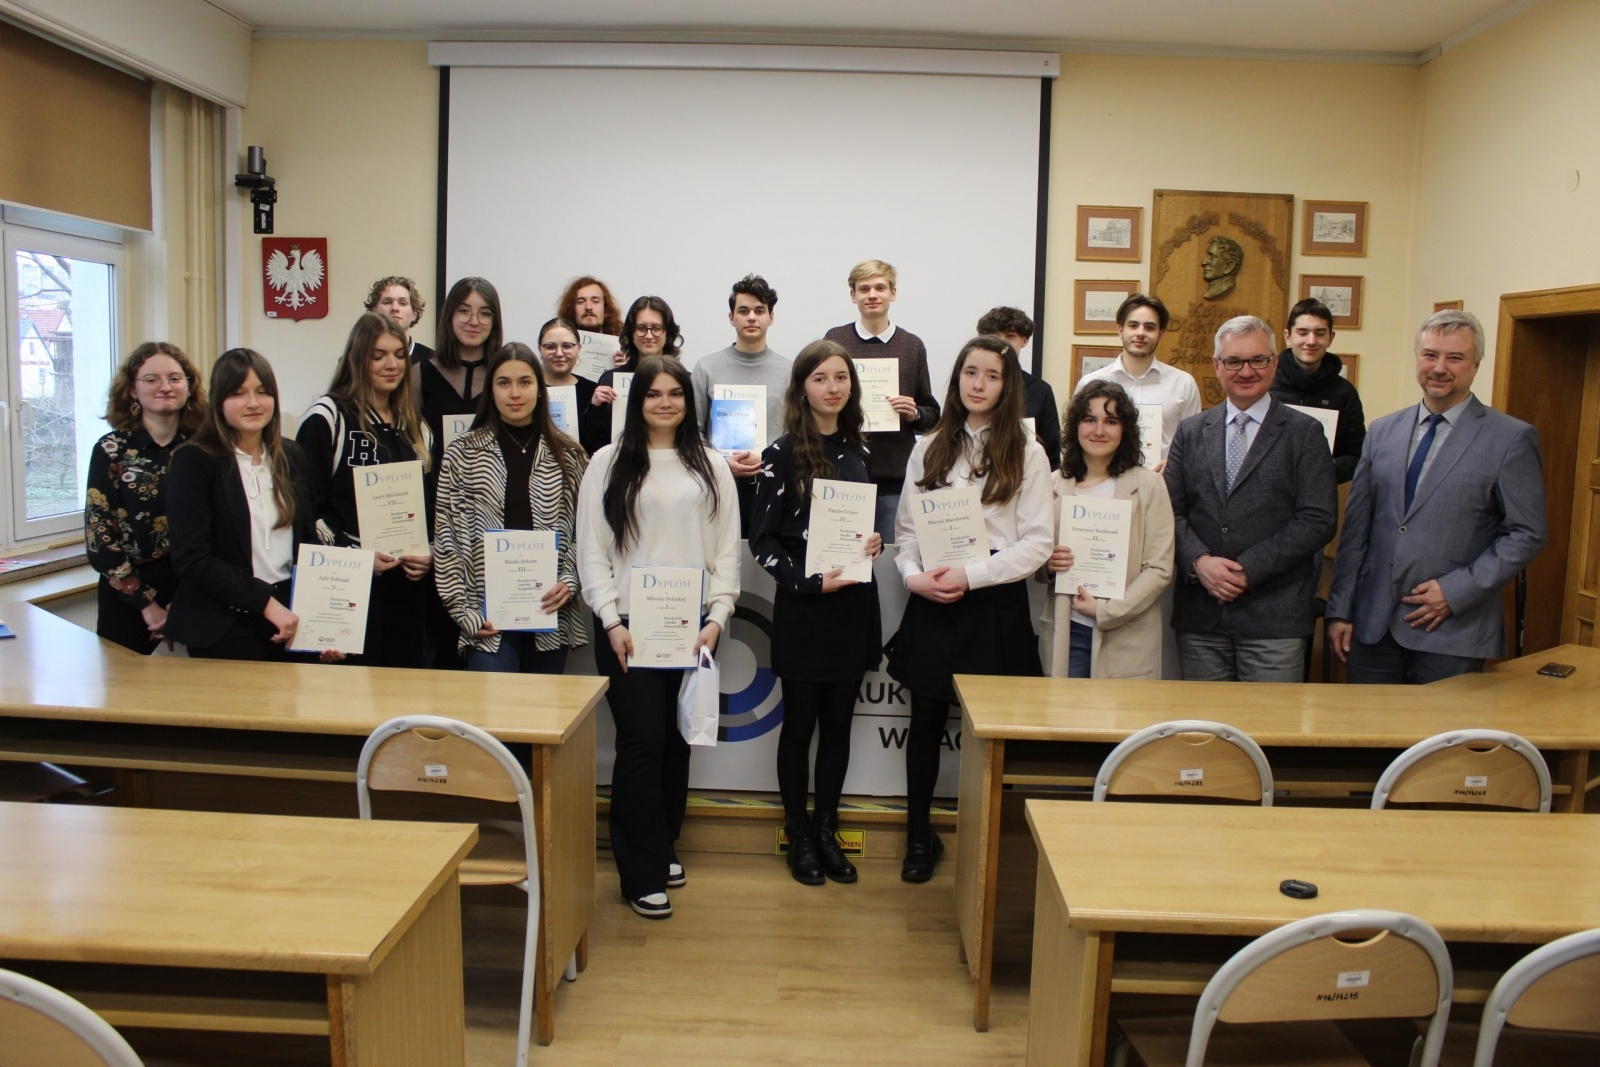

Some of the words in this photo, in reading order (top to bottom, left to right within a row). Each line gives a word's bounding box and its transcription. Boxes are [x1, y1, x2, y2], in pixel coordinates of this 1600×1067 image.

[582, 334, 614, 348] DYPLOM
[855, 363, 891, 374] DYPLOM
[722, 389, 758, 400] DYPLOM
[365, 471, 412, 487] DYPLOM
[822, 485, 866, 502] DYPLOM
[920, 498, 969, 514] DYPLOM
[1071, 504, 1120, 521] DYPLOM
[495, 538, 545, 553] DYPLOM
[309, 550, 362, 570] DYPLOM
[641, 574, 691, 589] DYPLOM
